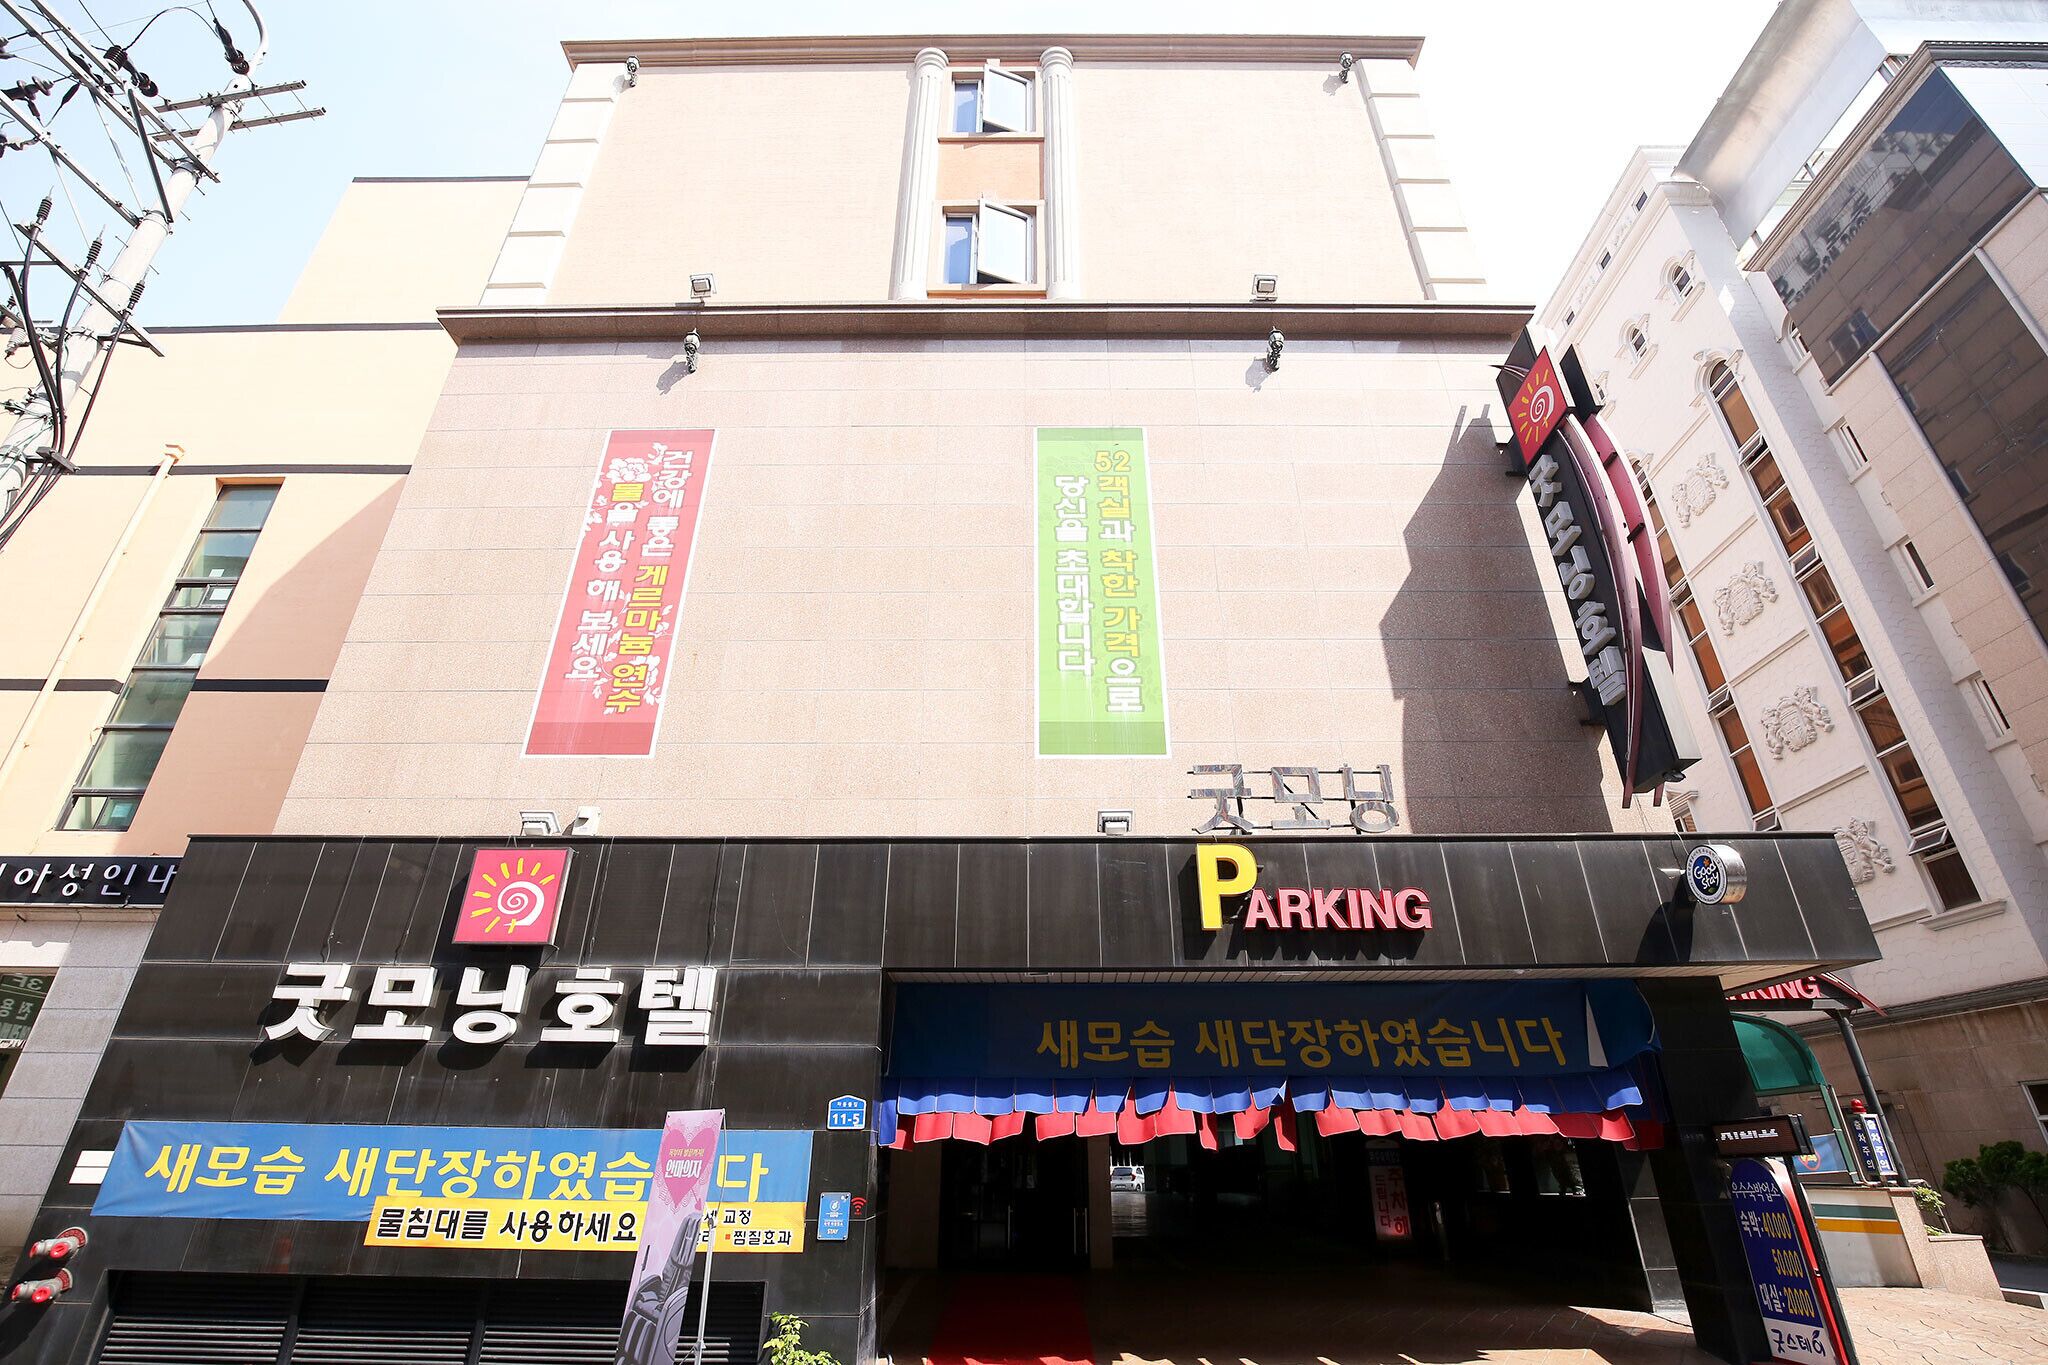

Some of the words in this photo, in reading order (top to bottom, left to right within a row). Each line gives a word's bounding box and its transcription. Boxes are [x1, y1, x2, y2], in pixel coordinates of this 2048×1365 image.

[605, 482, 646, 524] 물을
[651, 449, 694, 509] 건강에
[641, 515, 680, 558] 좋은
[1054, 474, 1091, 543] 당신을
[1101, 549, 1139, 598] 착한
[1528, 454, 1626, 706] 굿모닝호텔
[1055, 548, 1096, 677] 초대합니다
[564, 609, 617, 681] 보세요
[1102, 606, 1145, 713] 가격으로
[1190, 763, 1400, 835] 굿모닝
[0, 863, 177, 896] 아성인나
[1197, 842, 1433, 930] PARKING
[1694, 859, 1717, 880] Good
[263, 962, 717, 1046] 굿모닝호텔
[1036, 1019, 1176, 1069] 새모습
[1195, 1017, 1567, 1069] 새단장하였습니다
[832, 1113, 860, 1125] 11-5
[144, 1142, 306, 1196] 새모습
[324, 1147, 770, 1203] 새단장하였습다
[375, 1208, 489, 1240] 물침대를
[499, 1209, 637, 1244] 사용하세요
[724, 1210, 752, 1225] 교정
[733, 1229, 792, 1246] 찜질효과
